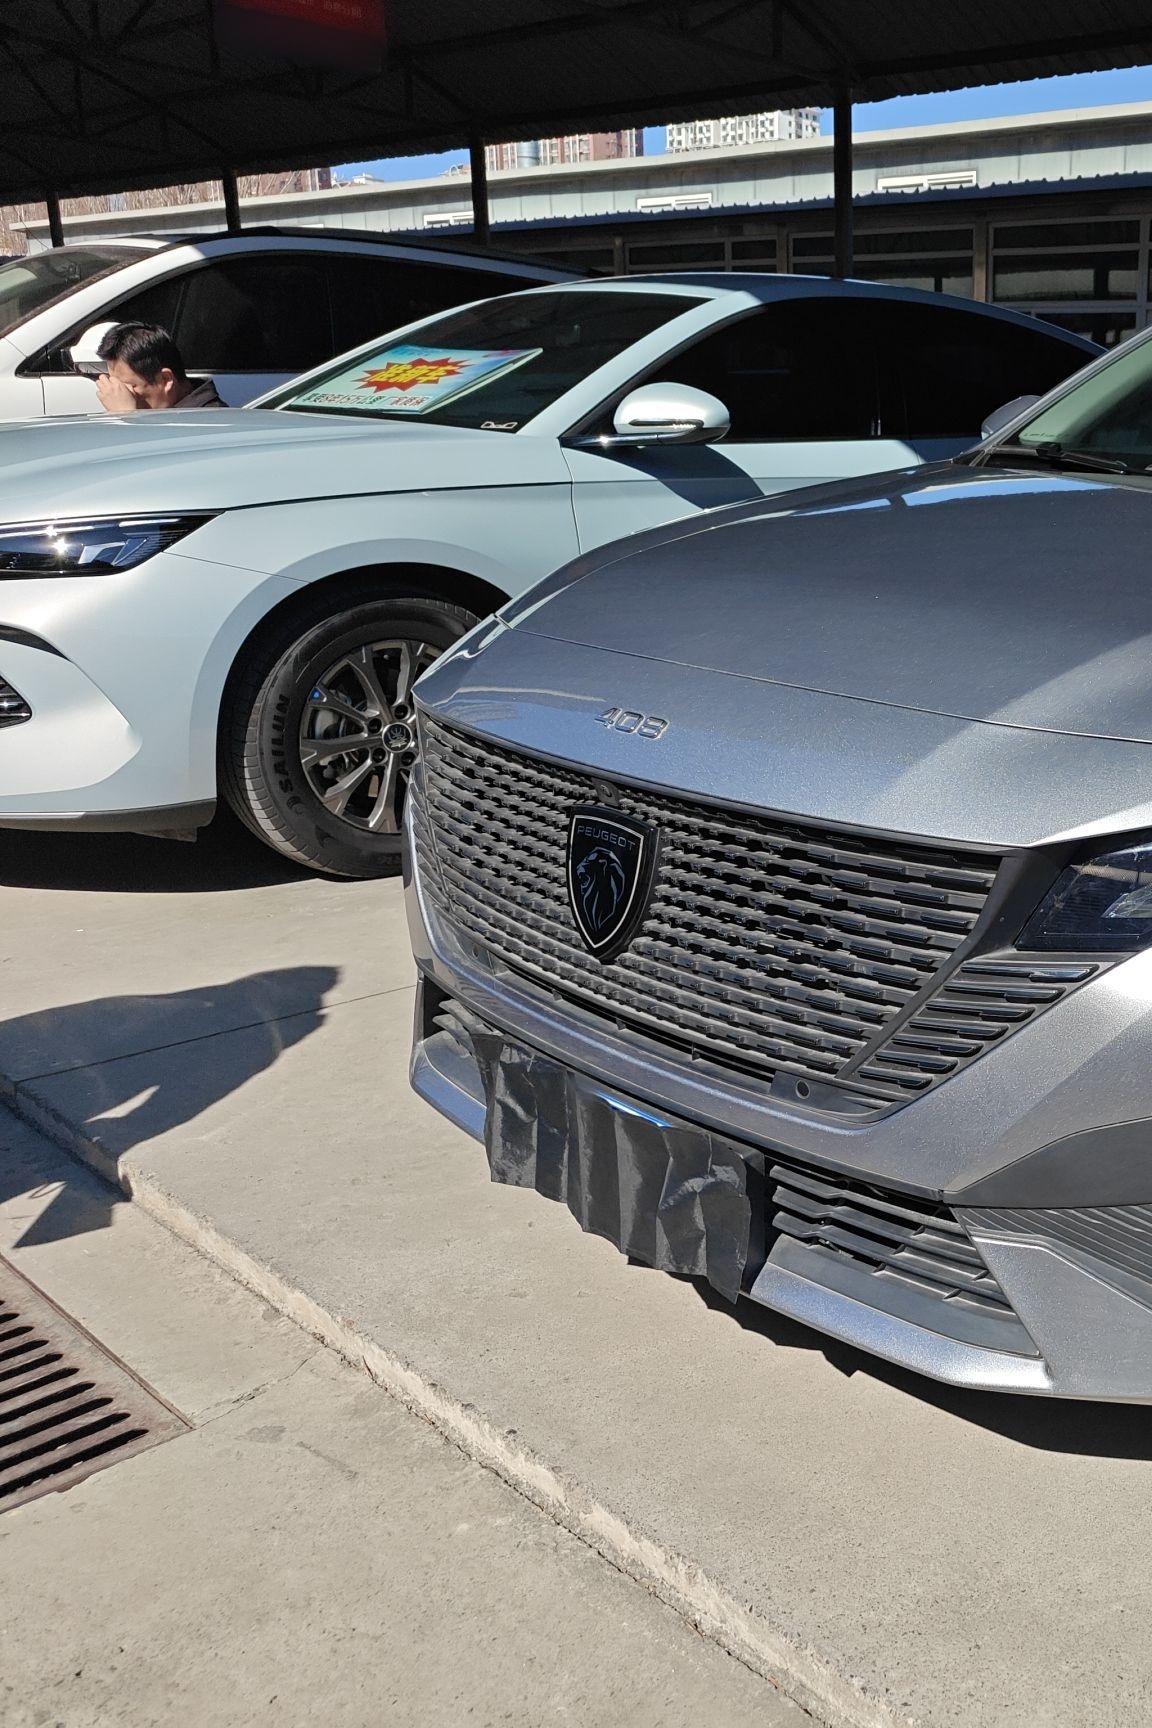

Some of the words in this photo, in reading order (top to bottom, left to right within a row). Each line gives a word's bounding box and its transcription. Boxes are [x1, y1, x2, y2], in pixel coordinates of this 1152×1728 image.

[594, 707, 670, 740] 408
[271, 694, 293, 793] SAILUN
[577, 824, 636, 851] PEUGEOT
